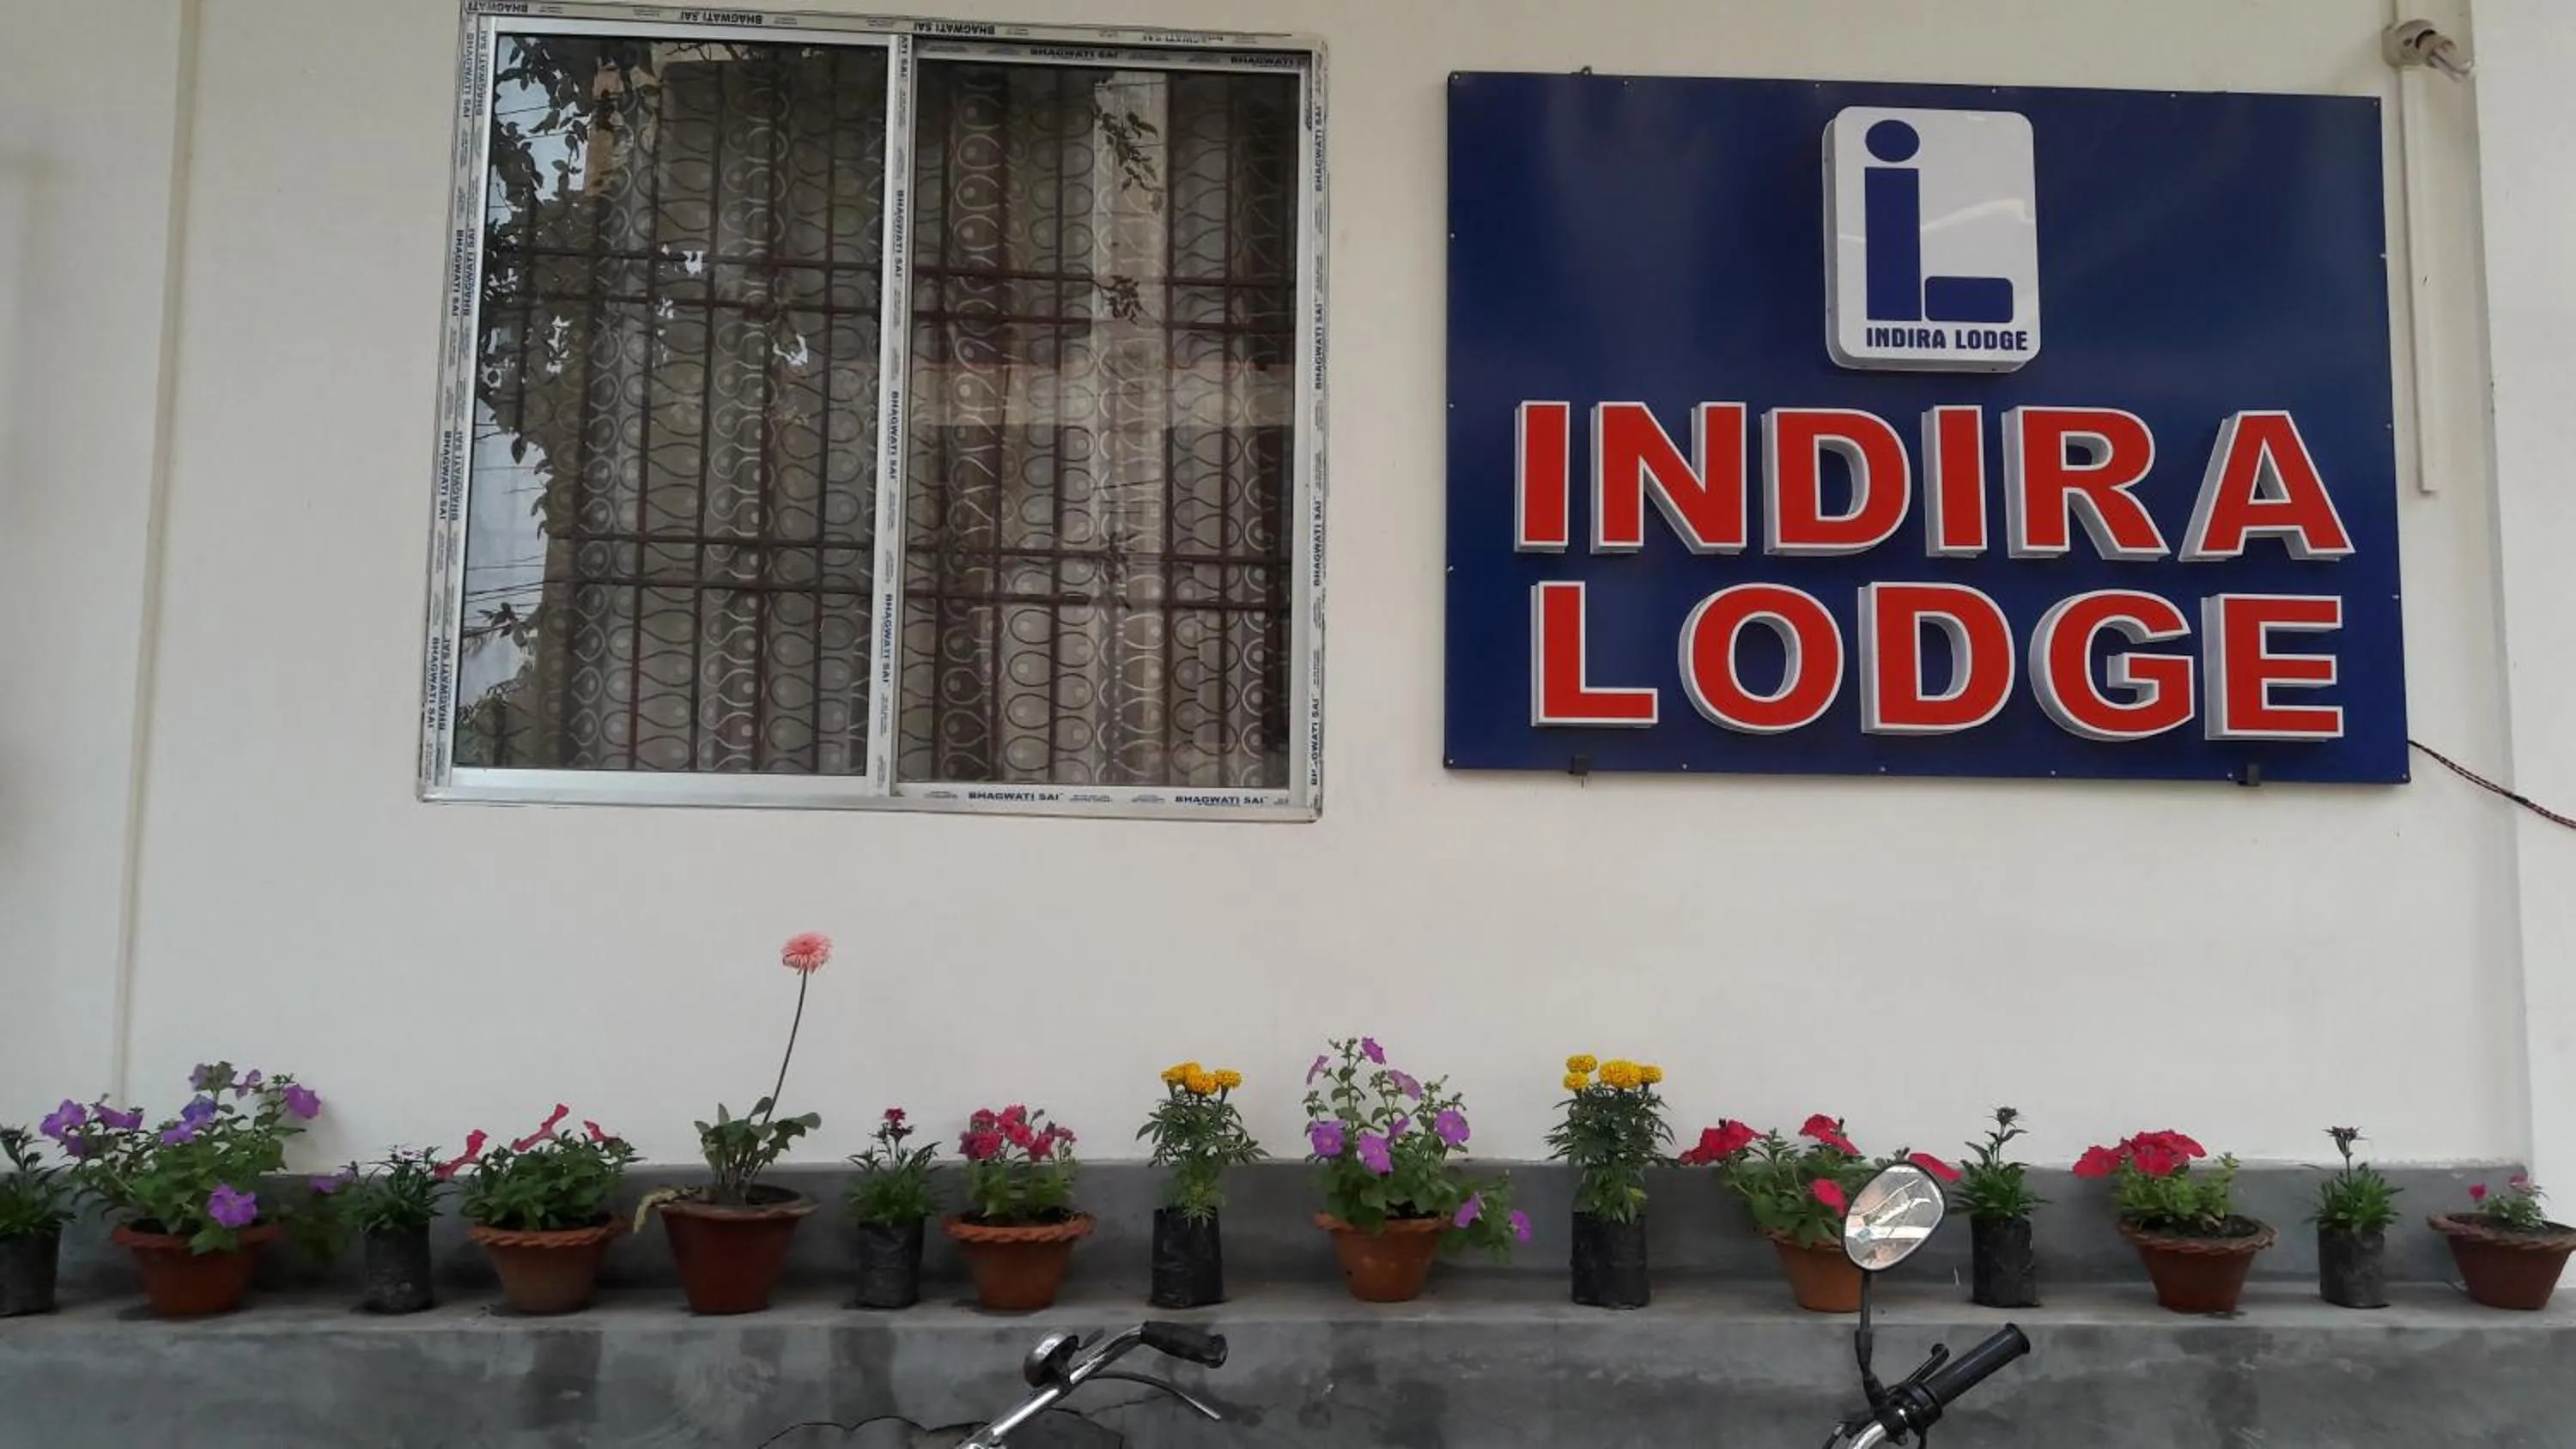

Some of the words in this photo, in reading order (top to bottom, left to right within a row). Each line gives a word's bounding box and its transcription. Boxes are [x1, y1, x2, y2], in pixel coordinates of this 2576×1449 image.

[702, 13, 762, 24] BHAGWATI
[935, 22, 994, 35] BHAGWATI
[464, 32, 474, 94] BHAGWATI
[477, 54, 488, 116] BHAGWATI
[894, 190, 903, 253] BHAGWATI
[453, 229, 464, 293] BHAGWATI
[464, 252, 475, 316] BHAGWATI
[1866, 327, 1947, 349] INDIRA
[1955, 330, 2027, 351] LODGE
[889, 391, 899, 455] BHAGWATI
[440, 430, 452, 495] BHAGWATI
[451, 456, 464, 521] BHAGWATI
[1515, 401, 2354, 561] INDIRA
[1314, 524, 1322, 586] BHAGWATI
[883, 594, 893, 659] BHAGWATI
[428, 637, 440, 703] BHAGWATI
[1531, 580, 2344, 743] LODGE
[438, 663, 450, 731] BHAGWATI
[969, 791, 1034, 802] BHAGWATI
[1175, 796, 1240, 805] BHAGWATI
